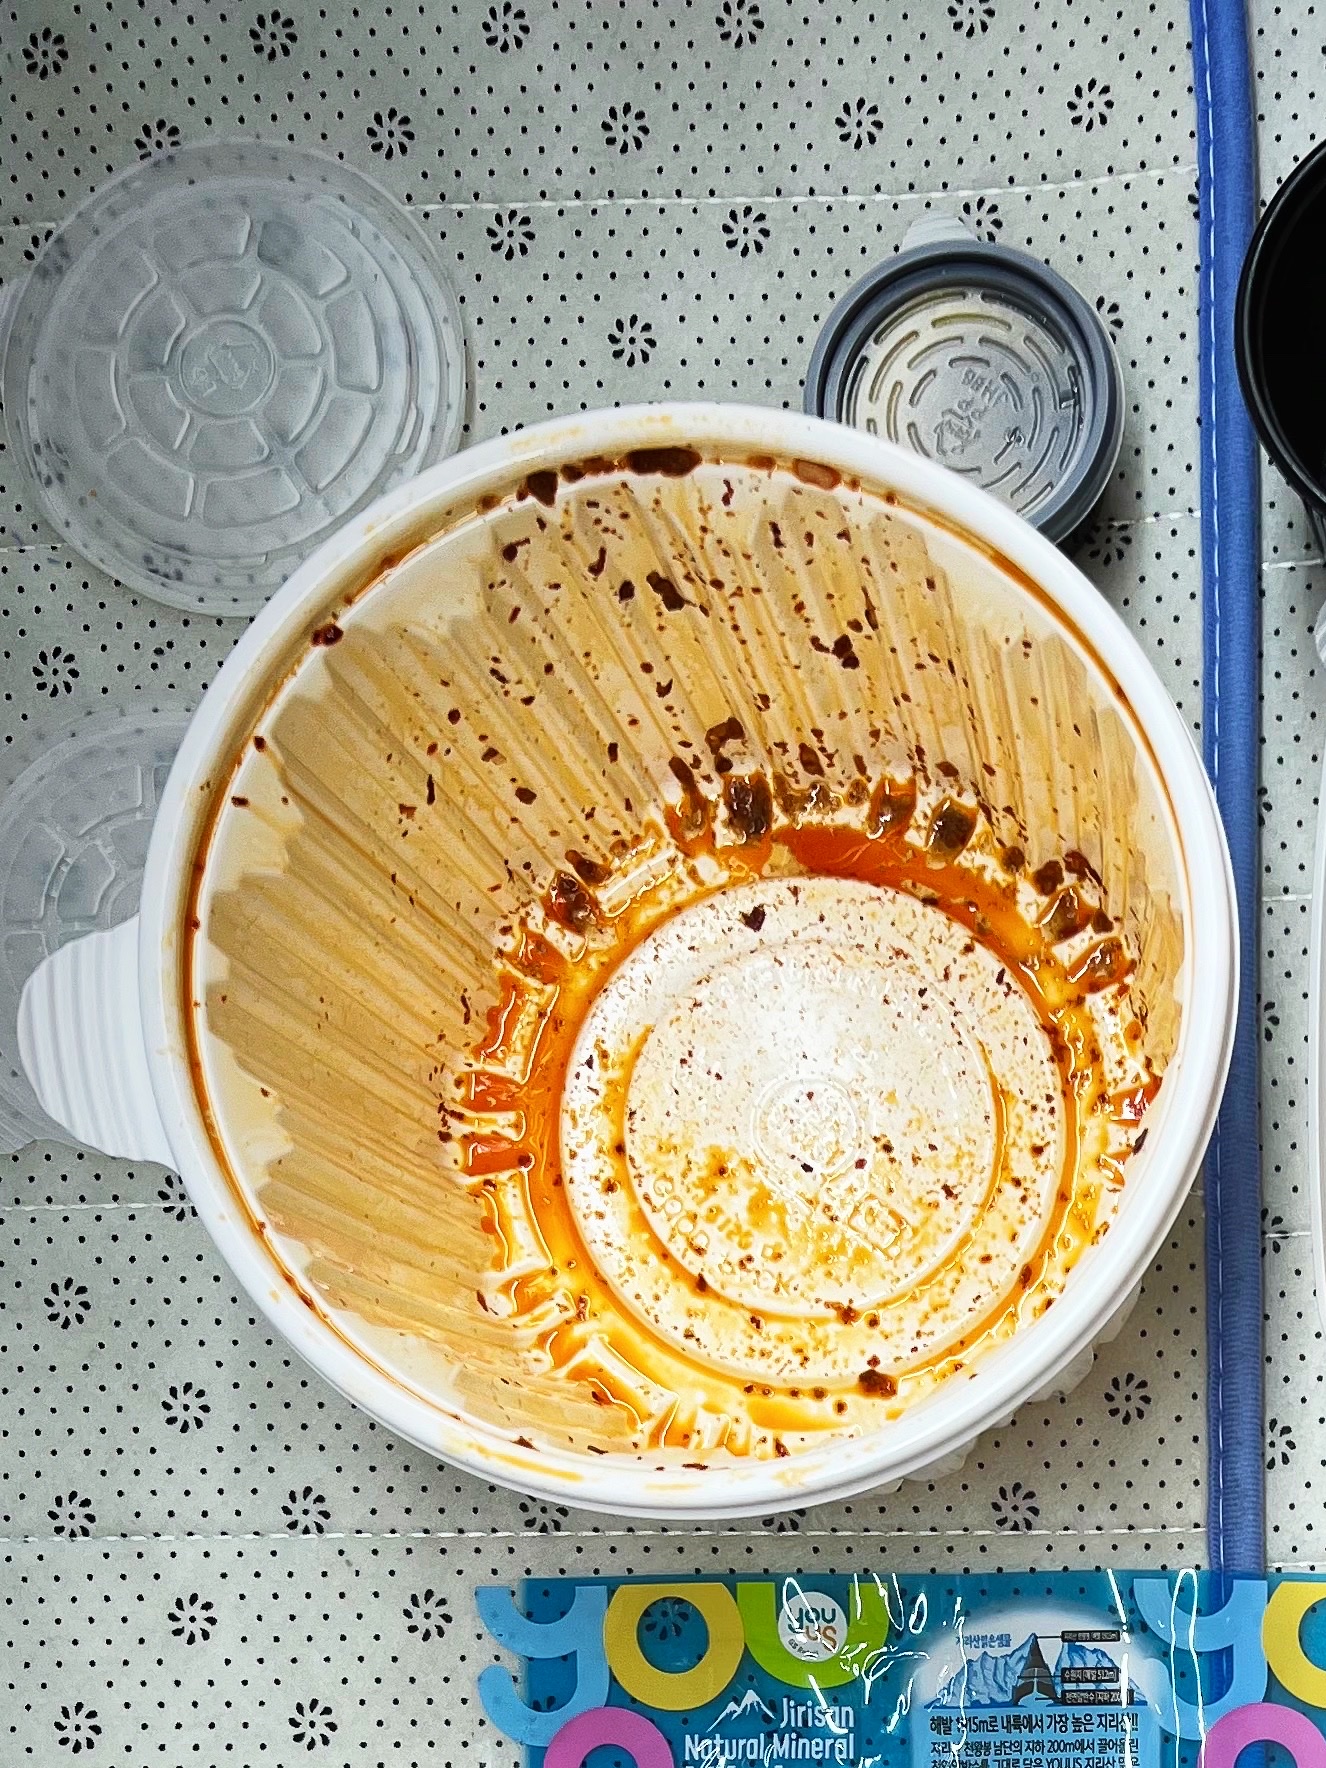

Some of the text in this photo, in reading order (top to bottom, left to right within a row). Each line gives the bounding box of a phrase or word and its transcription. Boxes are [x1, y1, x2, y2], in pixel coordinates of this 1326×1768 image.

[780, 1698, 854, 1728] Jirisan
[930, 1717, 953, 1736] 해발
[1001, 1715, 1044, 1733] 내륙에서
[1046, 1714, 1068, 1733] 가장
[1072, 1713, 1094, 1732] 높은
[685, 1733, 854, 1760] Natural Mineral
[994, 1740, 1022, 1755] 남단의
[1025, 1740, 1045, 1754] 지하
[1047, 1739, 1094, 1754] 200m에서
